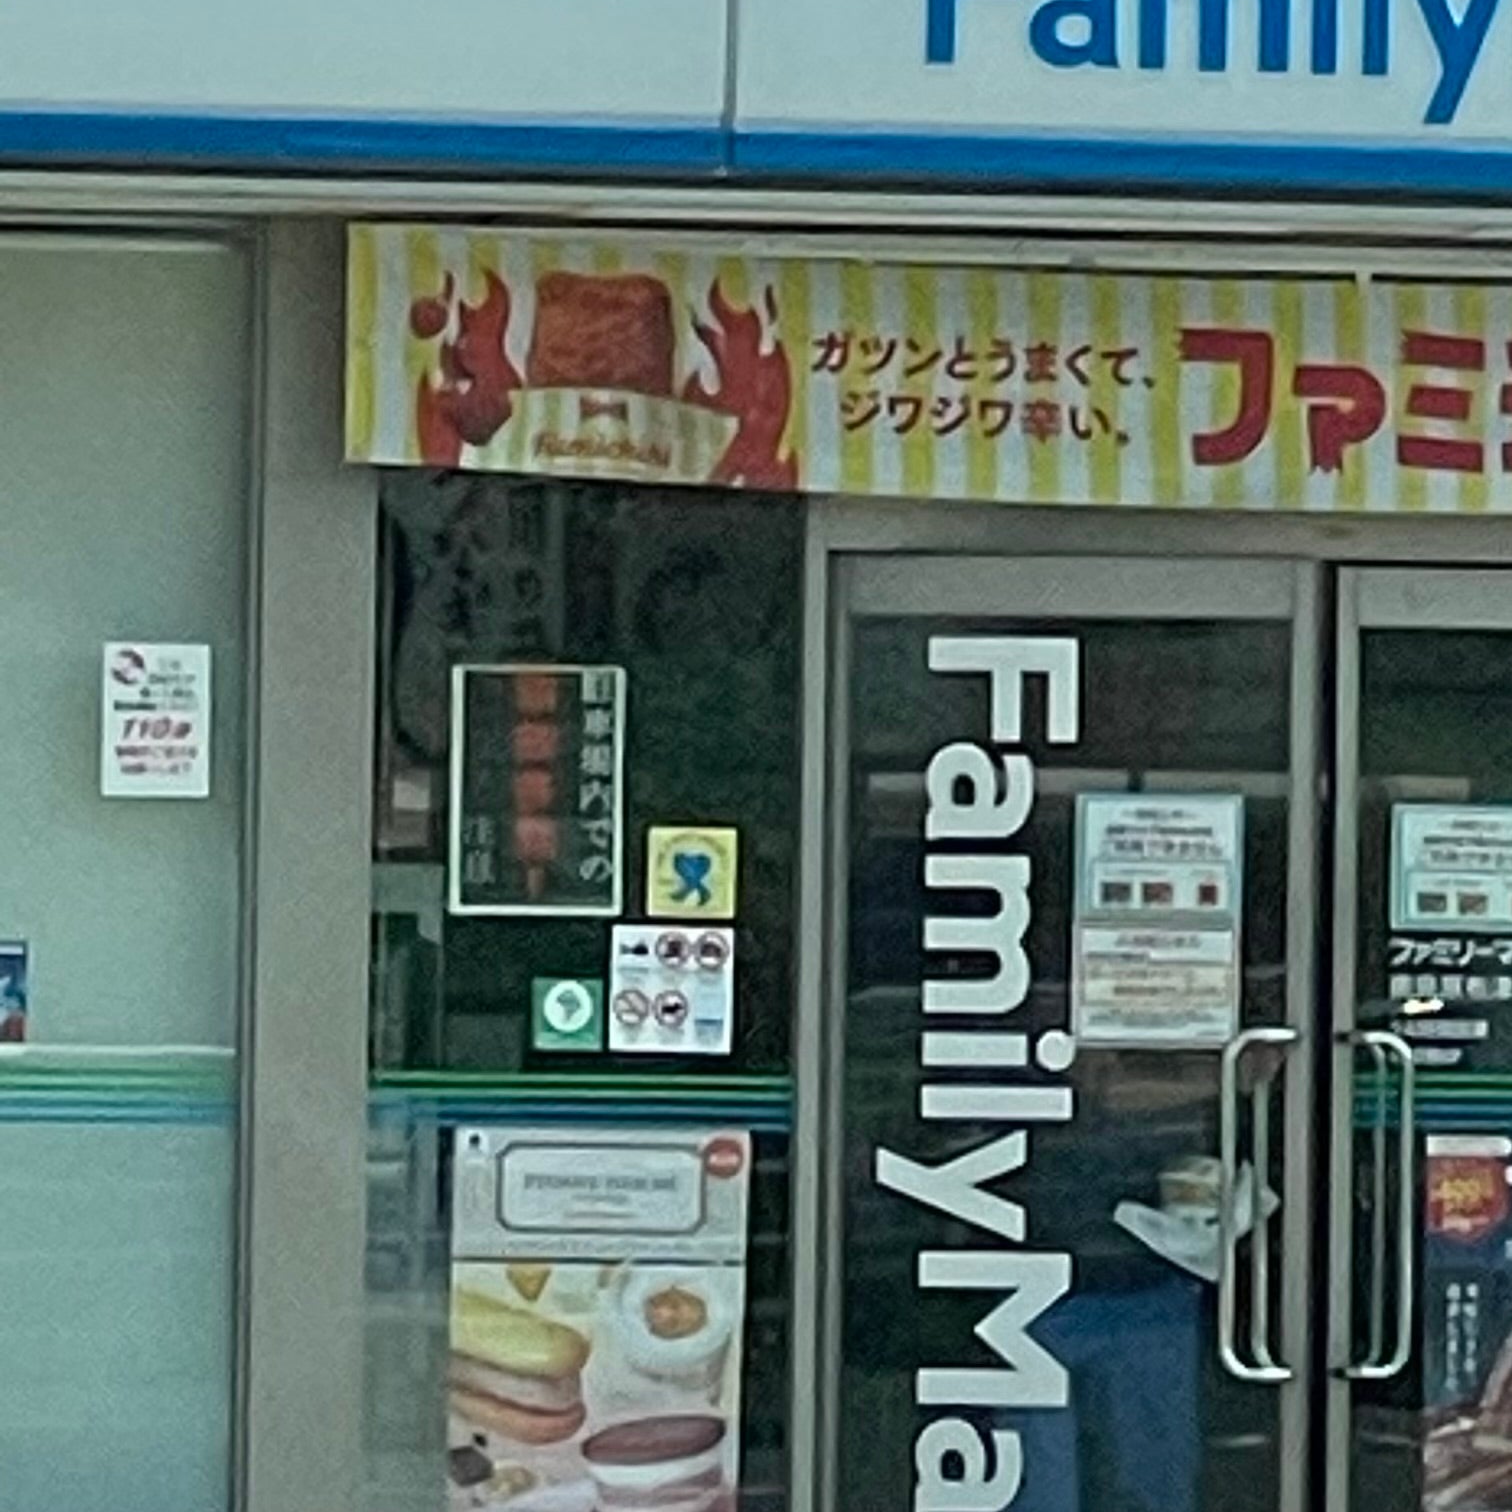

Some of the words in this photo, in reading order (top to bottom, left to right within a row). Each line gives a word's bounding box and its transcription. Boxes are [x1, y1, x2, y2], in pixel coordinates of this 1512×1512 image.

[811, 330, 1161, 391] ガツンとうまくて、
[840, 391, 1133, 445] ジワジワ辛い。
